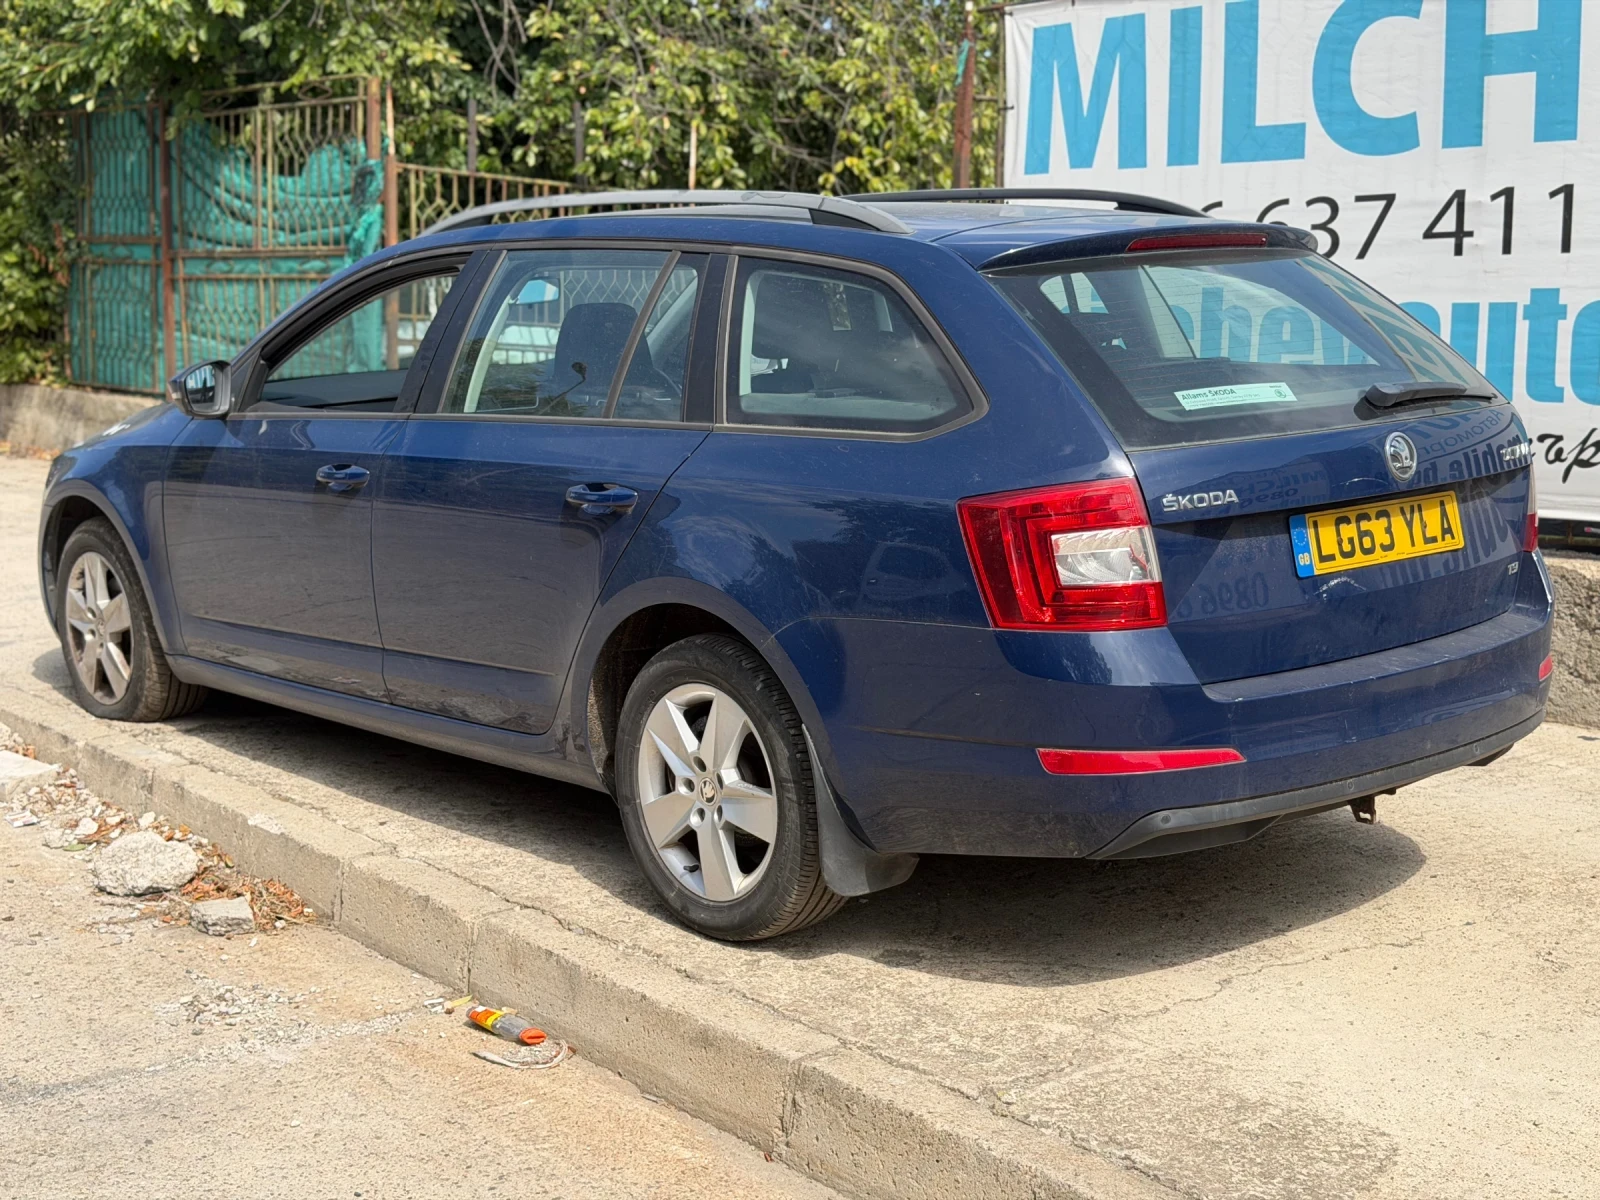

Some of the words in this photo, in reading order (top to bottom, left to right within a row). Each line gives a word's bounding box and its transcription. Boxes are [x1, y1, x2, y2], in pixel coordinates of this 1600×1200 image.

[1024, 0, 1583, 175] MILCH
[1422, 183, 1575, 257] 411
[1181, 391, 1209, 401] Allams
[1208, 388, 1237, 398] ŠKODA
[1162, 489, 1240, 512] ŠKODA
[1312, 508, 1396, 564] LG63
[1399, 499, 1456, 548] YLA
[1297, 552, 1311, 567] GB
